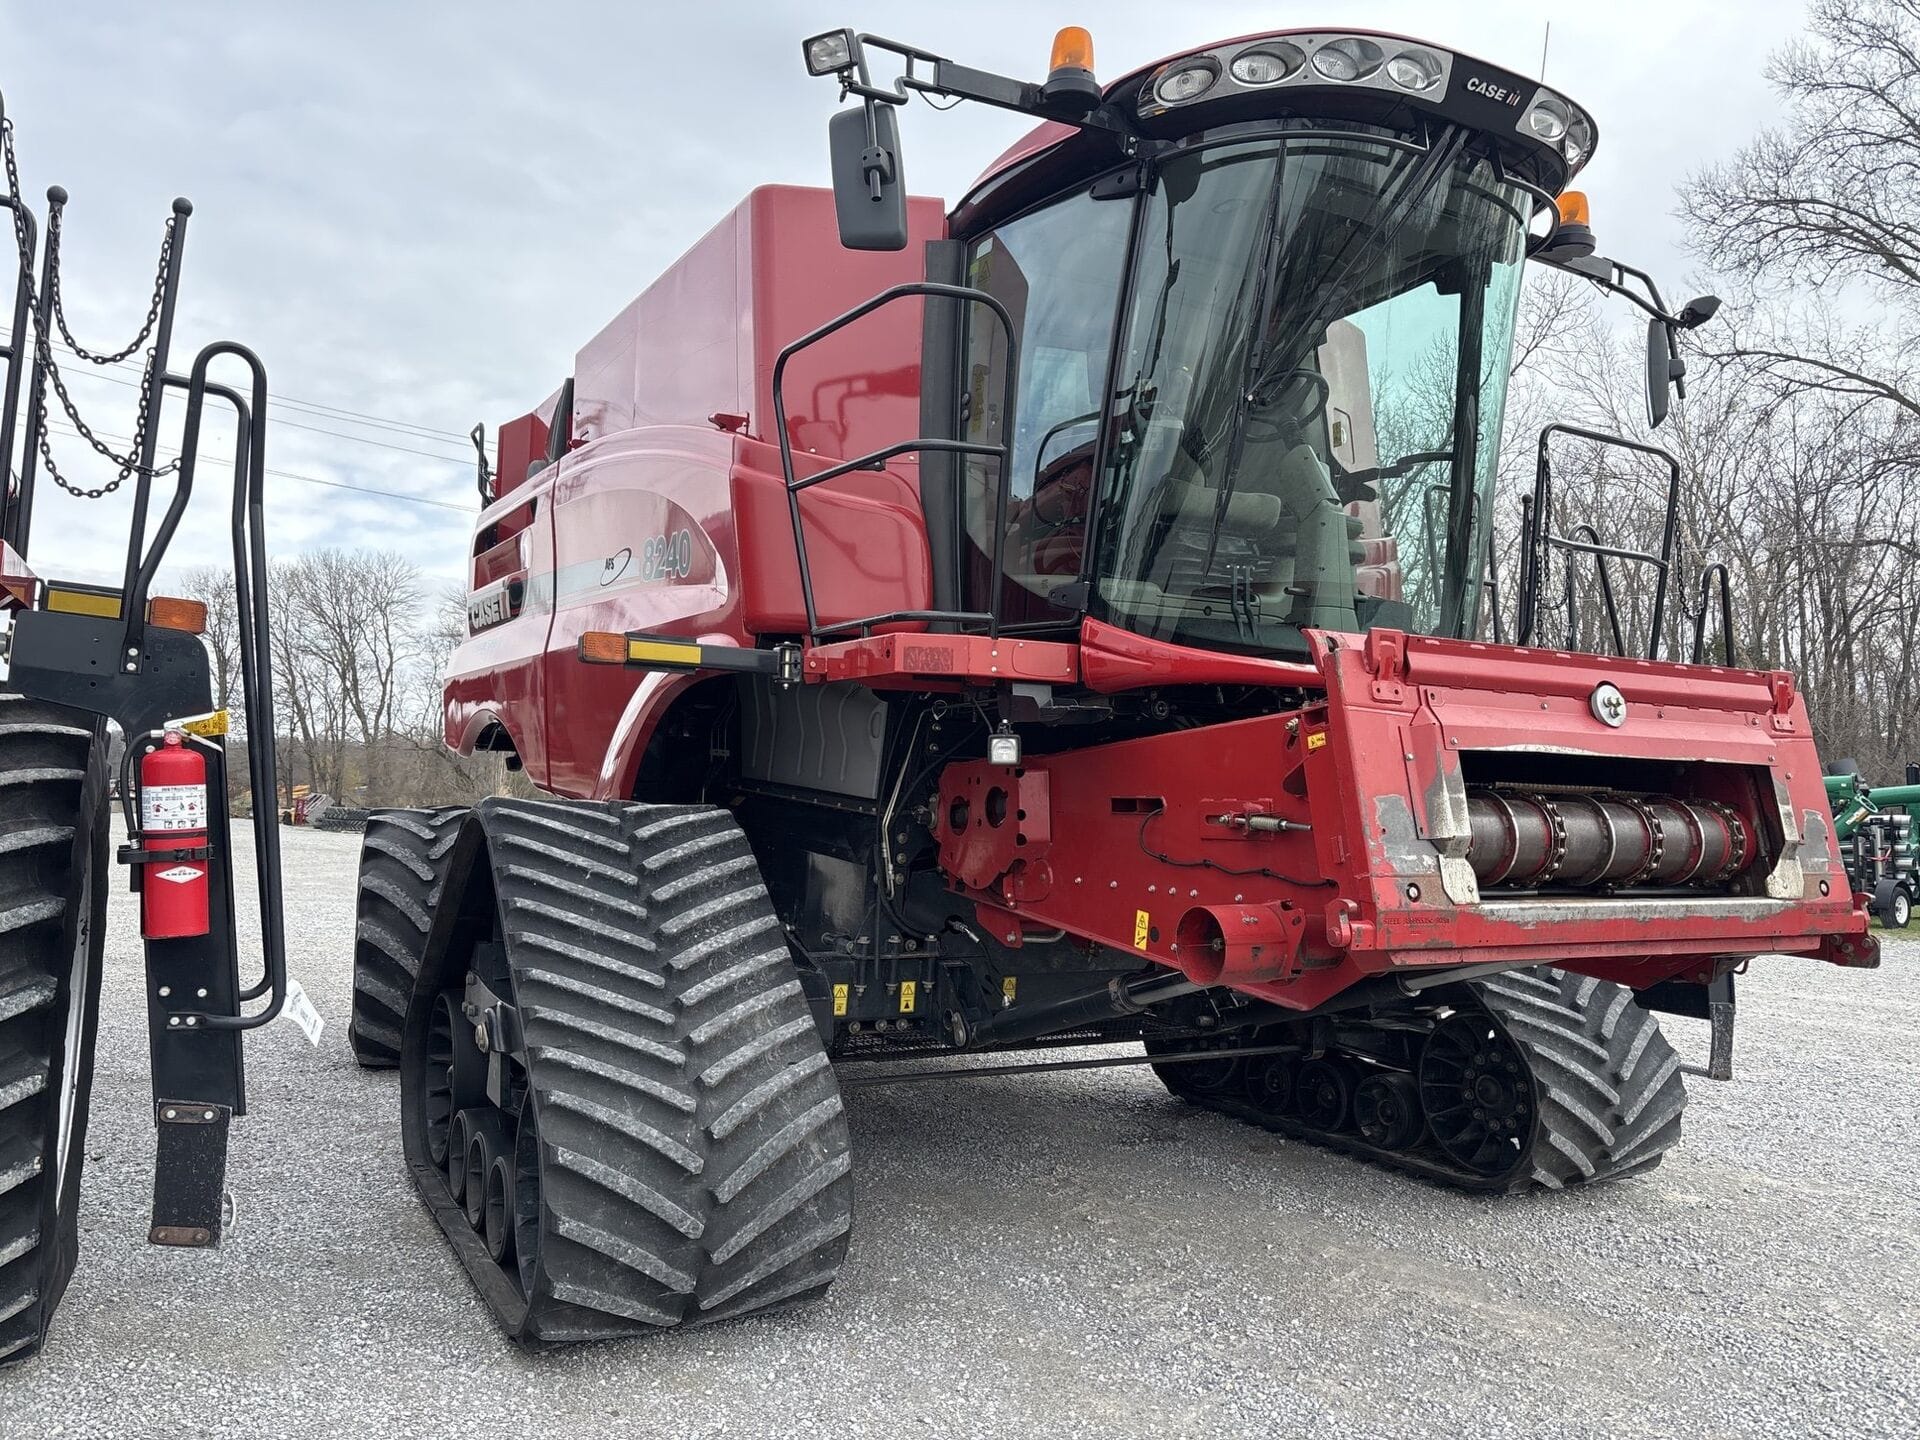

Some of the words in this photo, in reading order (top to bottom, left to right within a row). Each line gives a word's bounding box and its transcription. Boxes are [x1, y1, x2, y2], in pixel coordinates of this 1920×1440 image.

[1467, 77, 1507, 101] CASE
[605, 557, 615, 570] AFS
[643, 528, 691, 582] 8240
[471, 594, 500, 629] CASE
